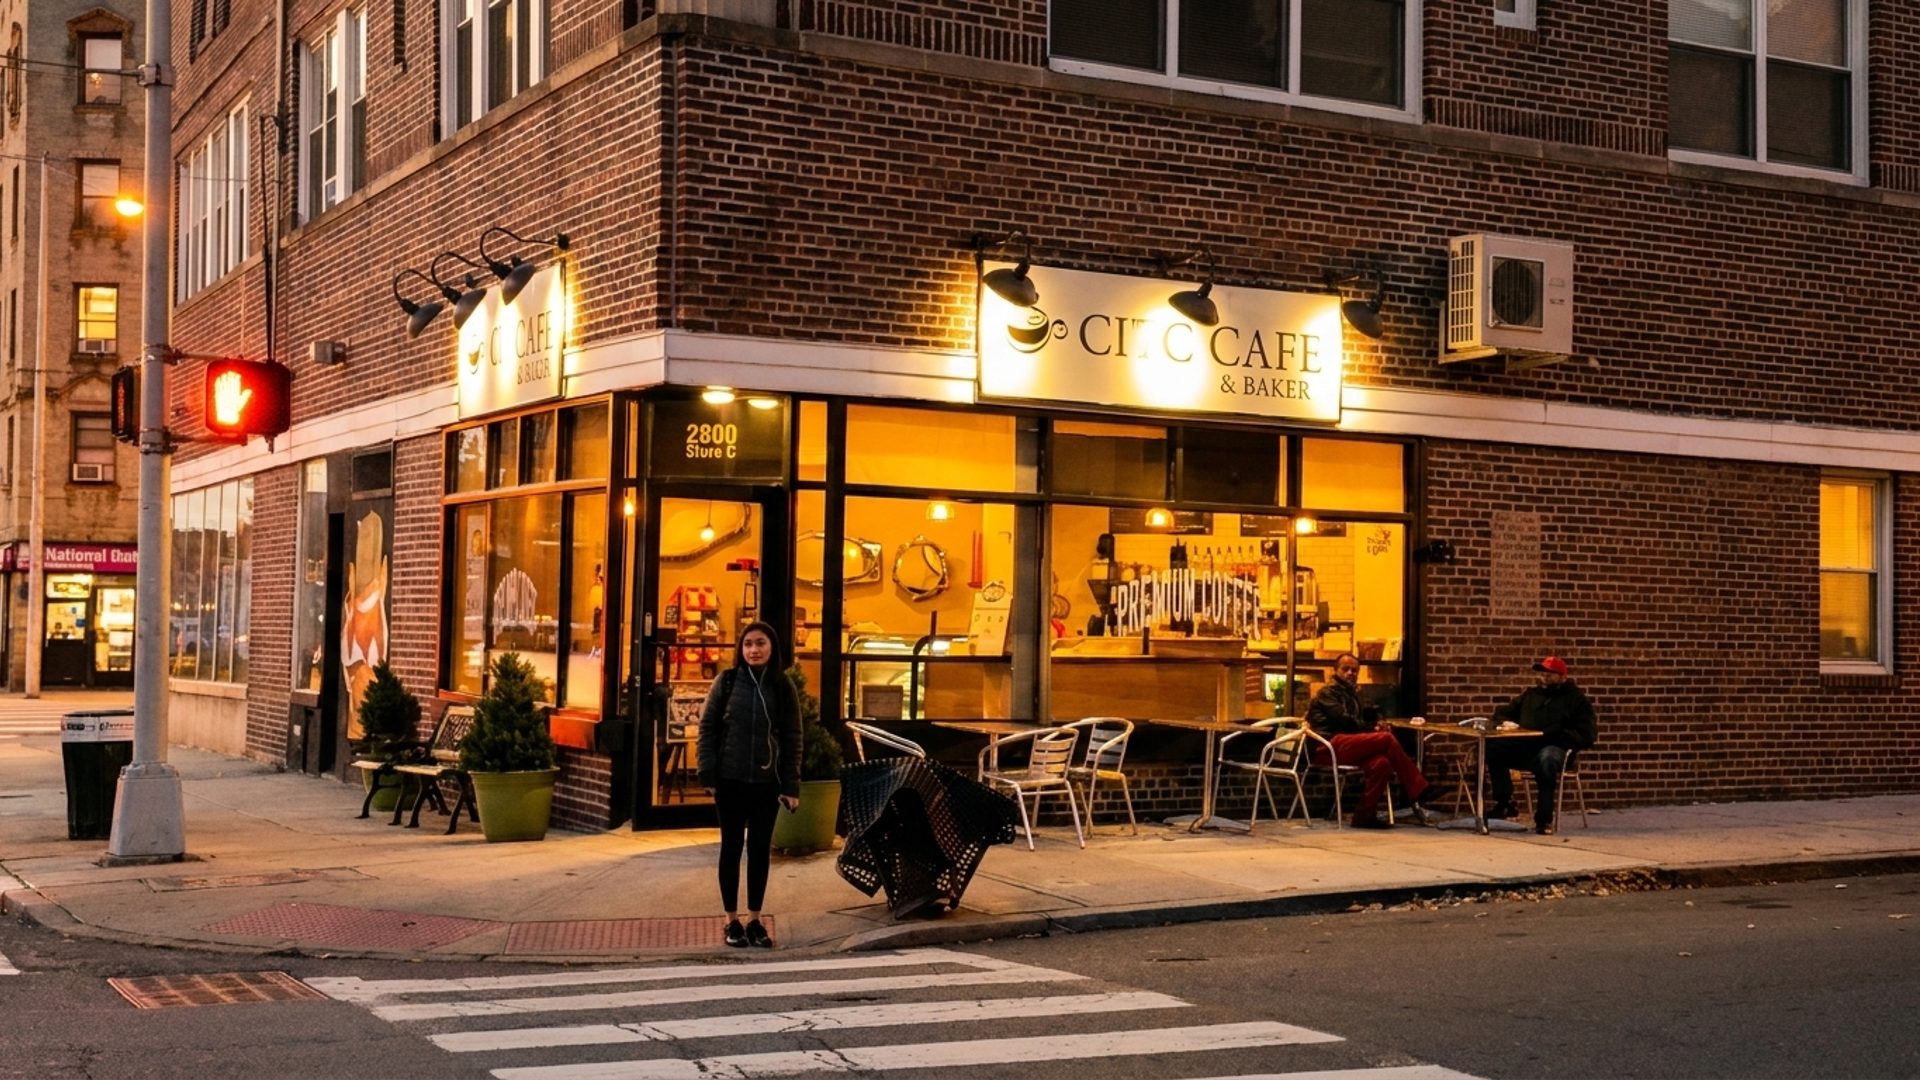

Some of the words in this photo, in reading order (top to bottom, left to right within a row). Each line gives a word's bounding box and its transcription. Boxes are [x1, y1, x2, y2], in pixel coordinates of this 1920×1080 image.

[516, 310, 553, 358] CAFE
[1210, 326, 1322, 373] CAFE
[1220, 374, 1236, 394] &
[1243, 376, 1310, 400] BAKER
[686, 423, 737, 444] 2800
[727, 445, 737, 458] C
